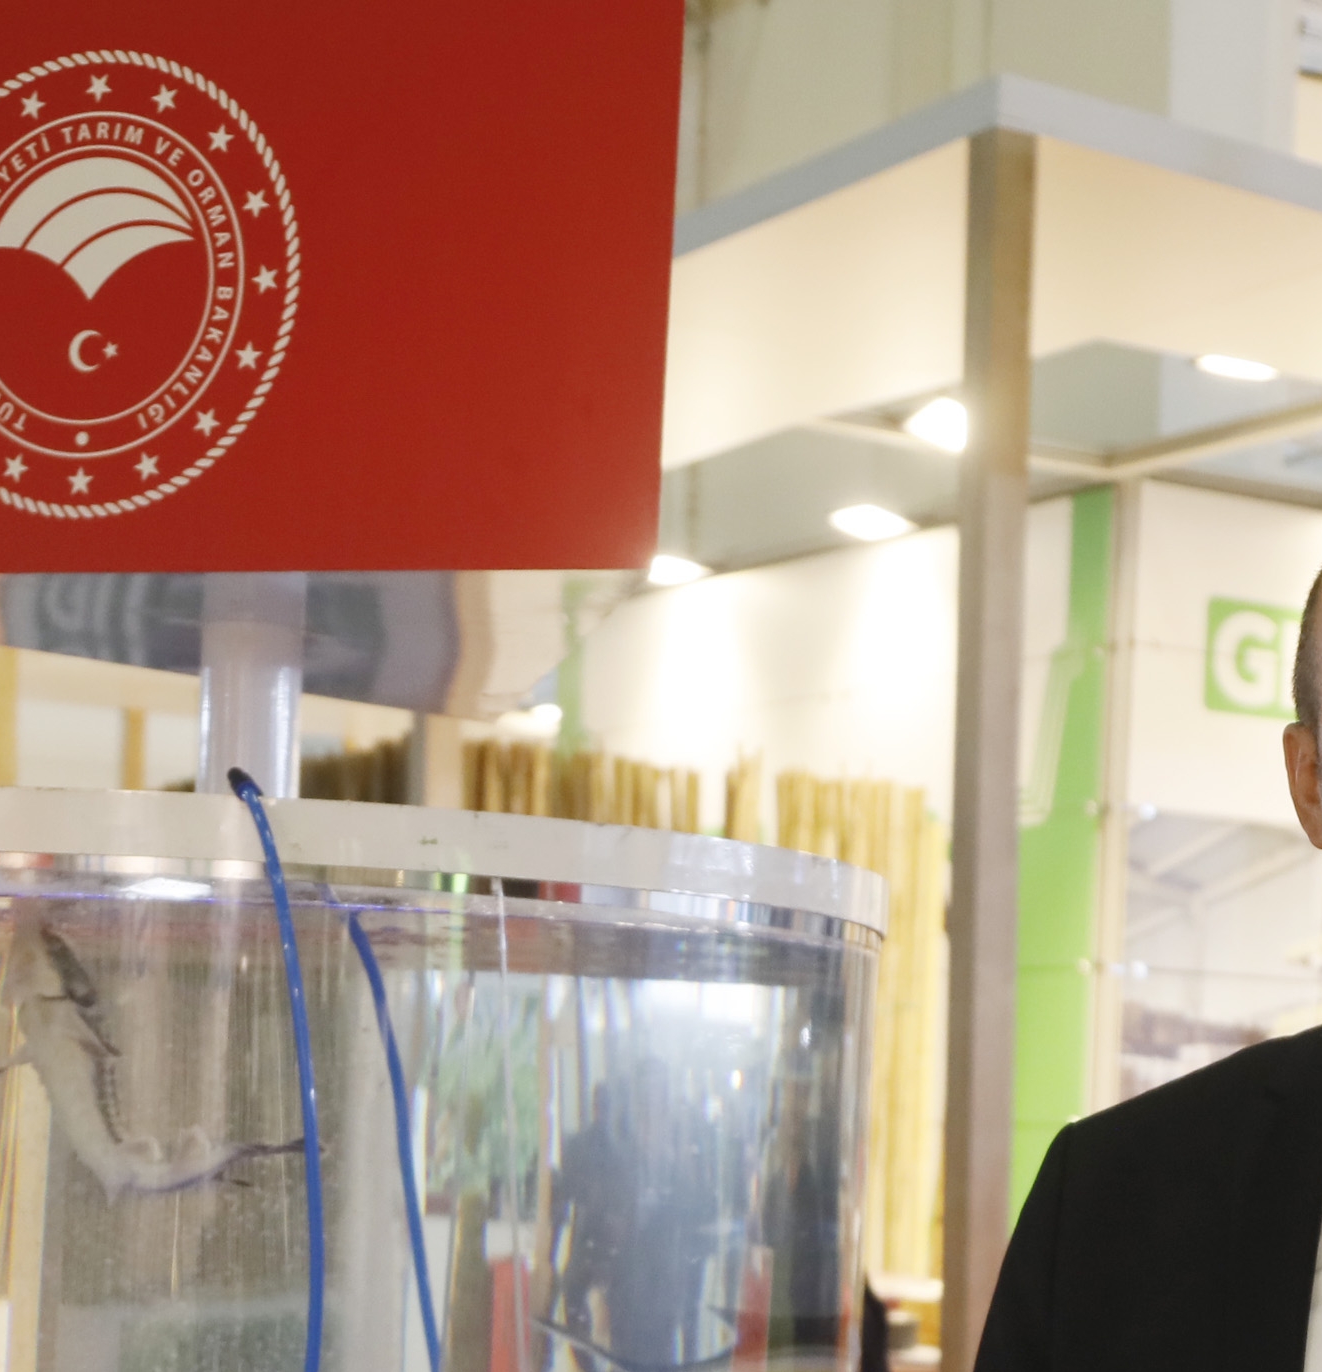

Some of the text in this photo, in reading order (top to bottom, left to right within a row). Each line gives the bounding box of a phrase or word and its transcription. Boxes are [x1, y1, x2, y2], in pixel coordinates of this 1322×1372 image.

[61, 121, 144, 145] TARIM
[154, 136, 185, 166] VE
[187, 168, 235, 269] ORMAN
[137, 286, 234, 430] BAKANLIĞI
